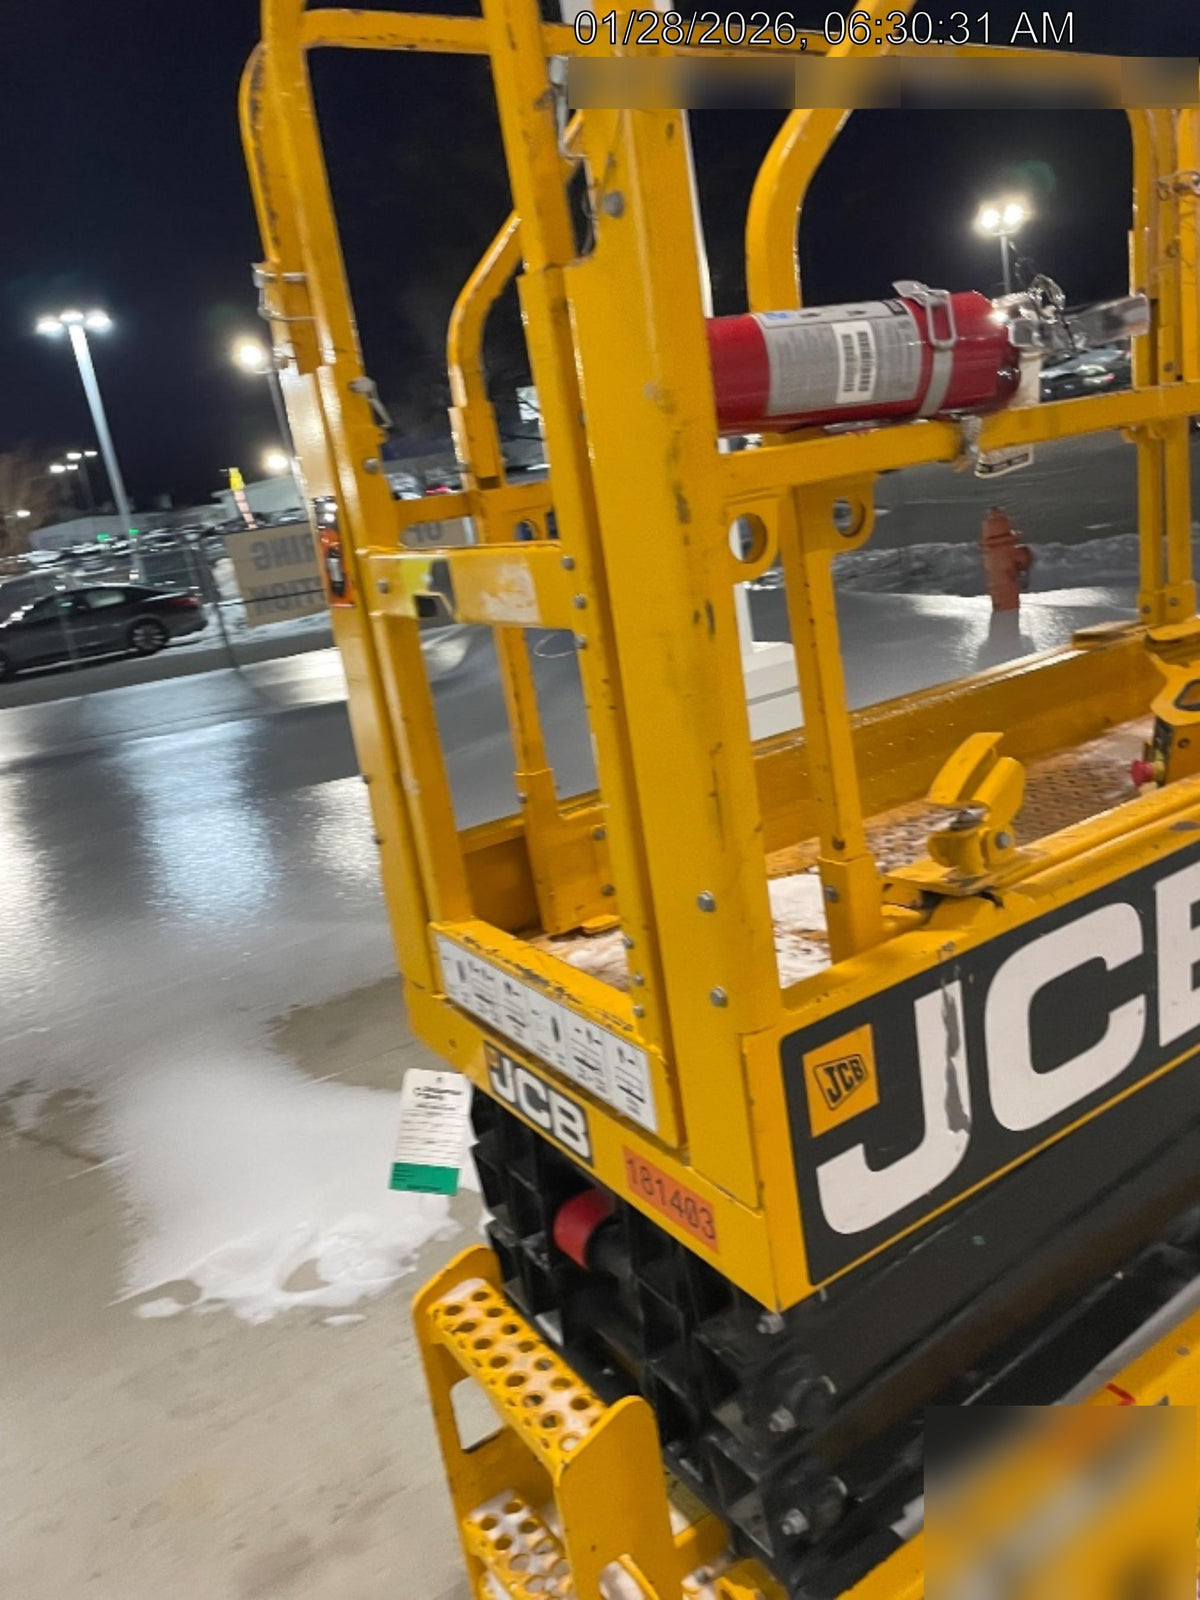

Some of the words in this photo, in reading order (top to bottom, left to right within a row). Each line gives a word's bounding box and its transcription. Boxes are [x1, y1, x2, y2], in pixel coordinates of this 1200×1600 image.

[490, 1056, 591, 1159] JCB
[823, 1058, 864, 1104] JCB
[626, 1158, 716, 1240] 181403
